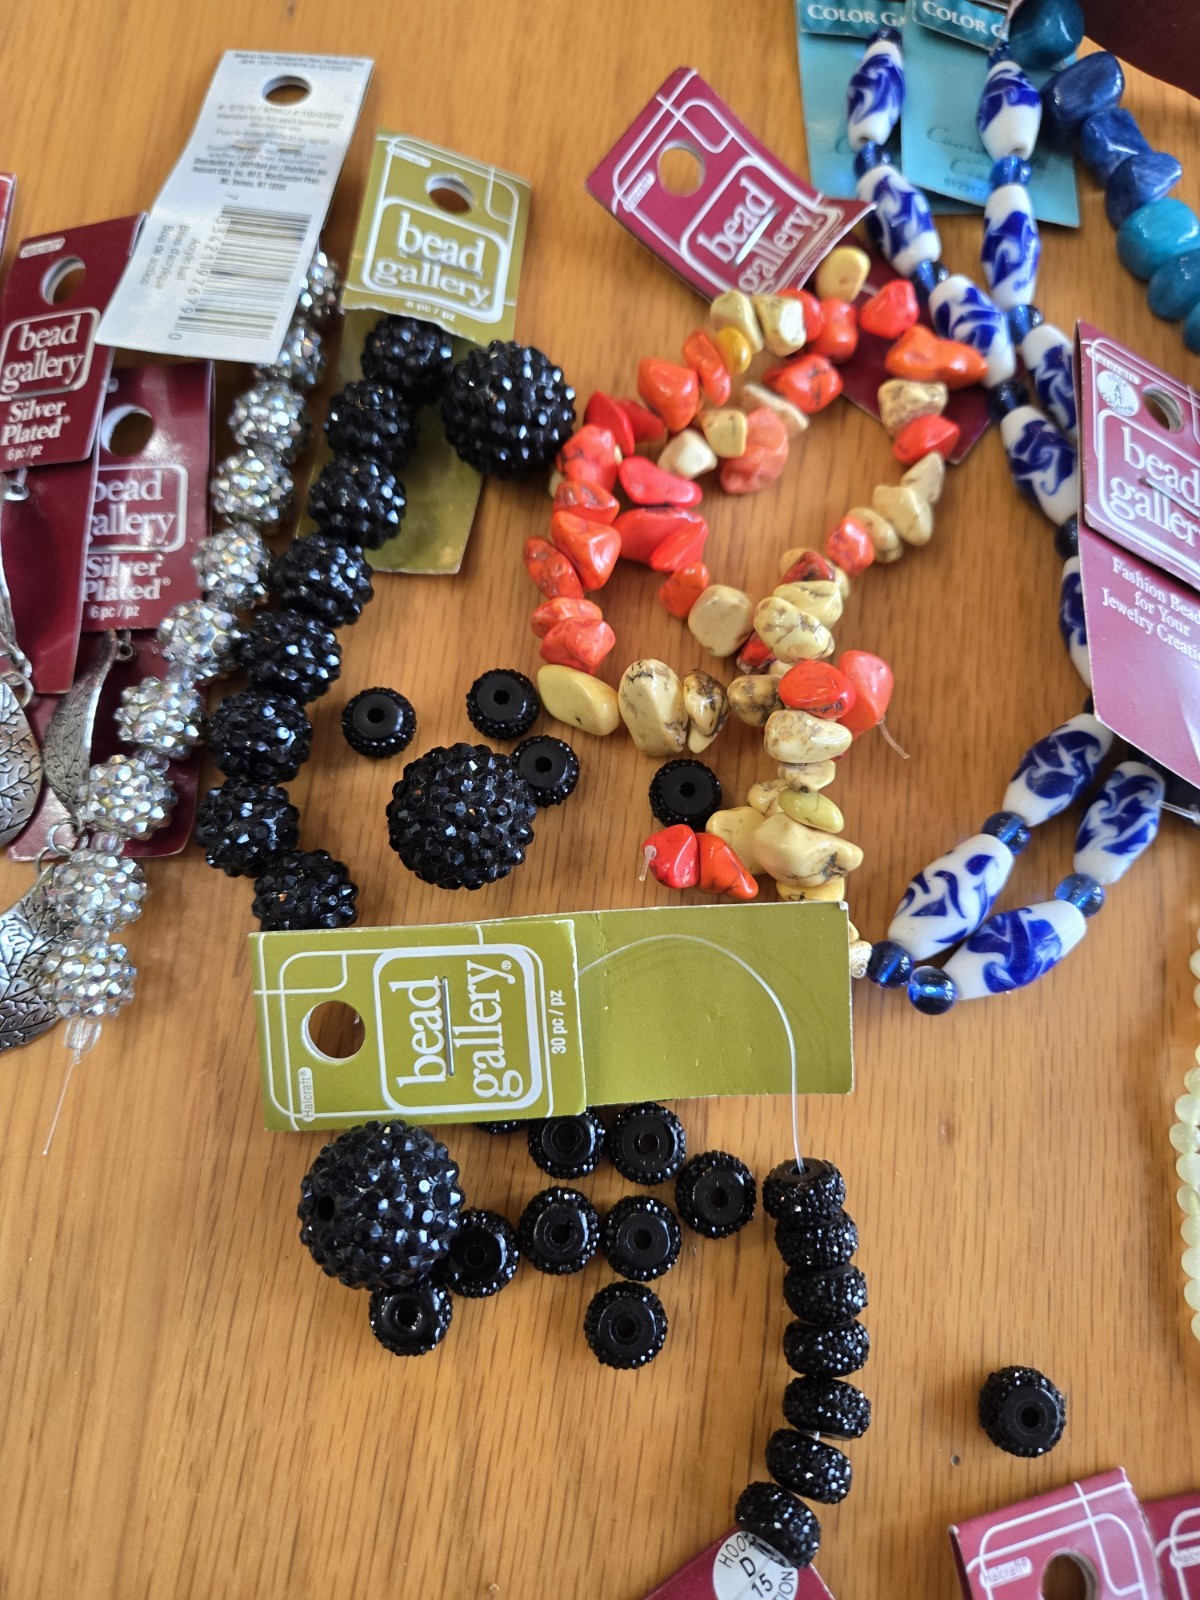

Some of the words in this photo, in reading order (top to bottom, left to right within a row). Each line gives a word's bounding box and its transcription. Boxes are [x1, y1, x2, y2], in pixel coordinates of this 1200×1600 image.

[807, 4, 878, 25] COLOR
[923, 1, 988, 34] COLOR
[200, 216, 231, 262] 33421
[696, 175, 775, 263] bead
[398, 209, 486, 279] bead
[738, 204, 819, 295] gallery
[181, 268, 210, 316] 97679
[374, 257, 490, 307] gallery
[19, 314, 81, 351] bead
[1, 349, 85, 393] gallery
[9, 399, 67, 423] Silver
[1121, 426, 1200, 508] bead
[91, 502, 177, 545] allery
[1109, 477, 1200, 547] galler
[86, 555, 162, 578] Silver
[1112, 556, 1167, 604] Fashion
[1102, 587, 1155, 634] Jewelry
[1134, 591, 1155, 614] for
[1156, 605, 1191, 636] Your
[548, 1008, 564, 1016] /
[550, 989, 566, 1006] pz
[388, 975, 449, 1089] bead
[550, 1037, 567, 1054] 30
[552, 1018, 568, 1034] pc
[739, 1556, 756, 1578] D
[751, 1573, 773, 1598] 15
